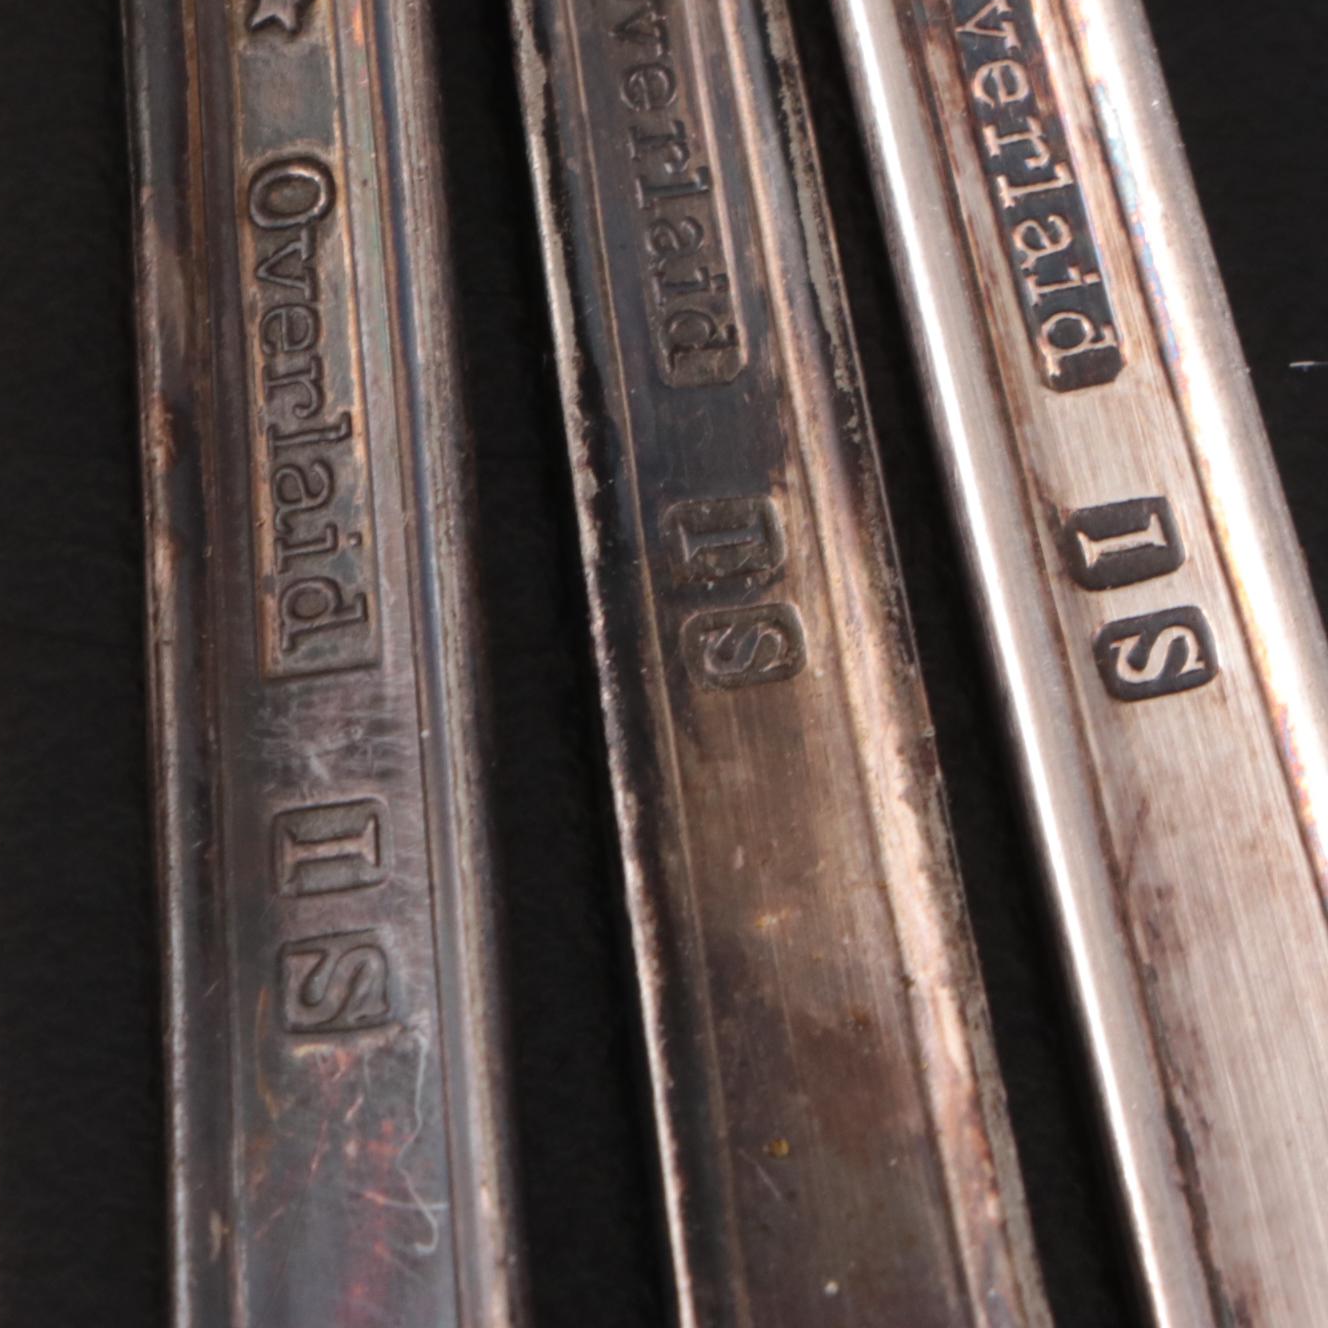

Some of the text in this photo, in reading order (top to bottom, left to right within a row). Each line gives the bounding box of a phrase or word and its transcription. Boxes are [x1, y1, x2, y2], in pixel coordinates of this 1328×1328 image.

[247, 153, 368, 655] Overlaid
[1076, 512, 1167, 572] I
[704, 624, 786, 673] S
[1112, 625, 1205, 685] S
[281, 816, 379, 886] I
[286, 948, 388, 1032] S
